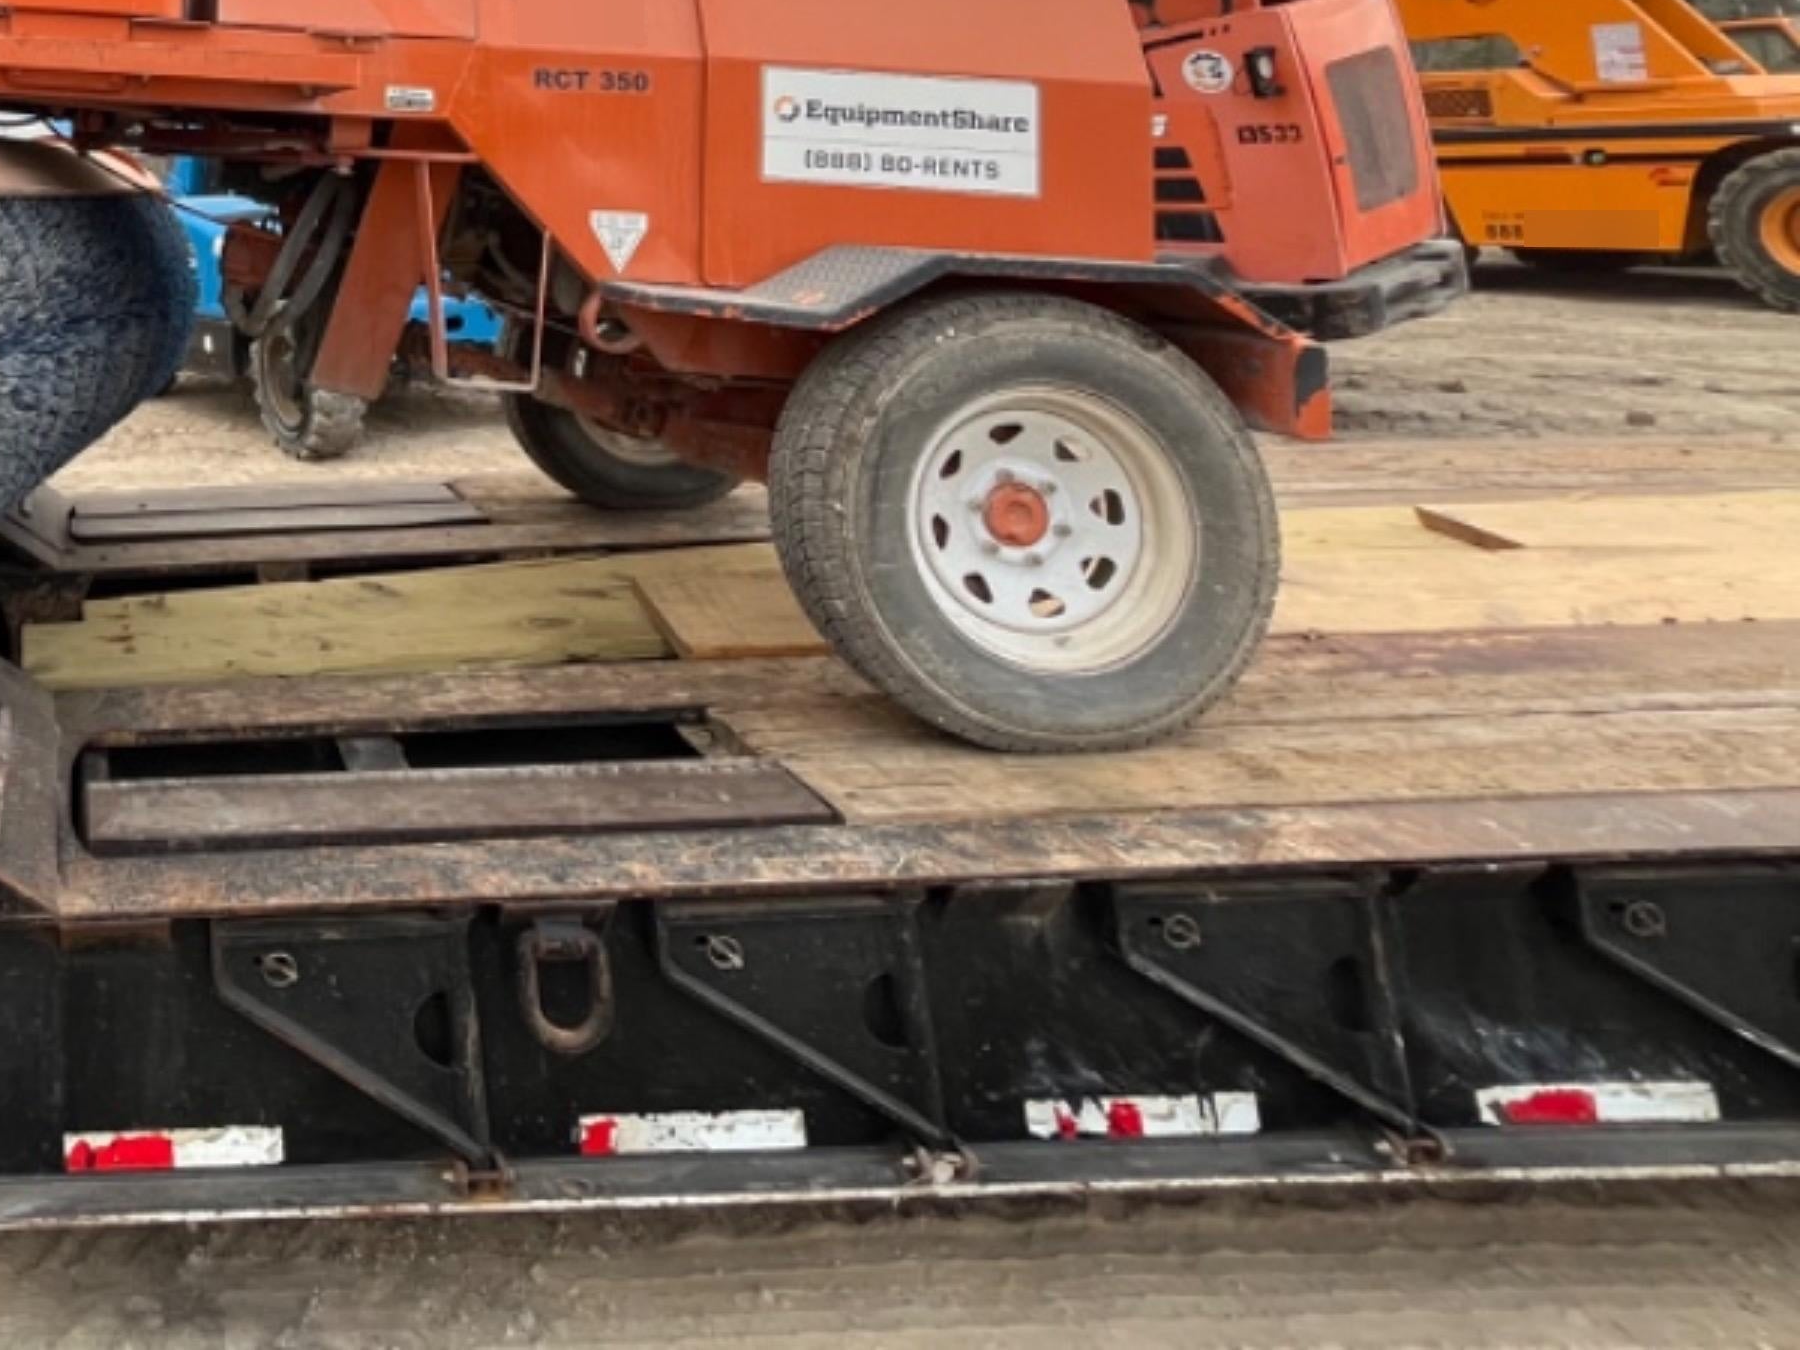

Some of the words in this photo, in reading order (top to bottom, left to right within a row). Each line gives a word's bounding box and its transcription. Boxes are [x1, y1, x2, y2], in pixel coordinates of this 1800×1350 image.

[534, 69, 590, 89] RCT
[600, 71, 650, 91] 350
[805, 98, 1031, 134] EquipmentShare
